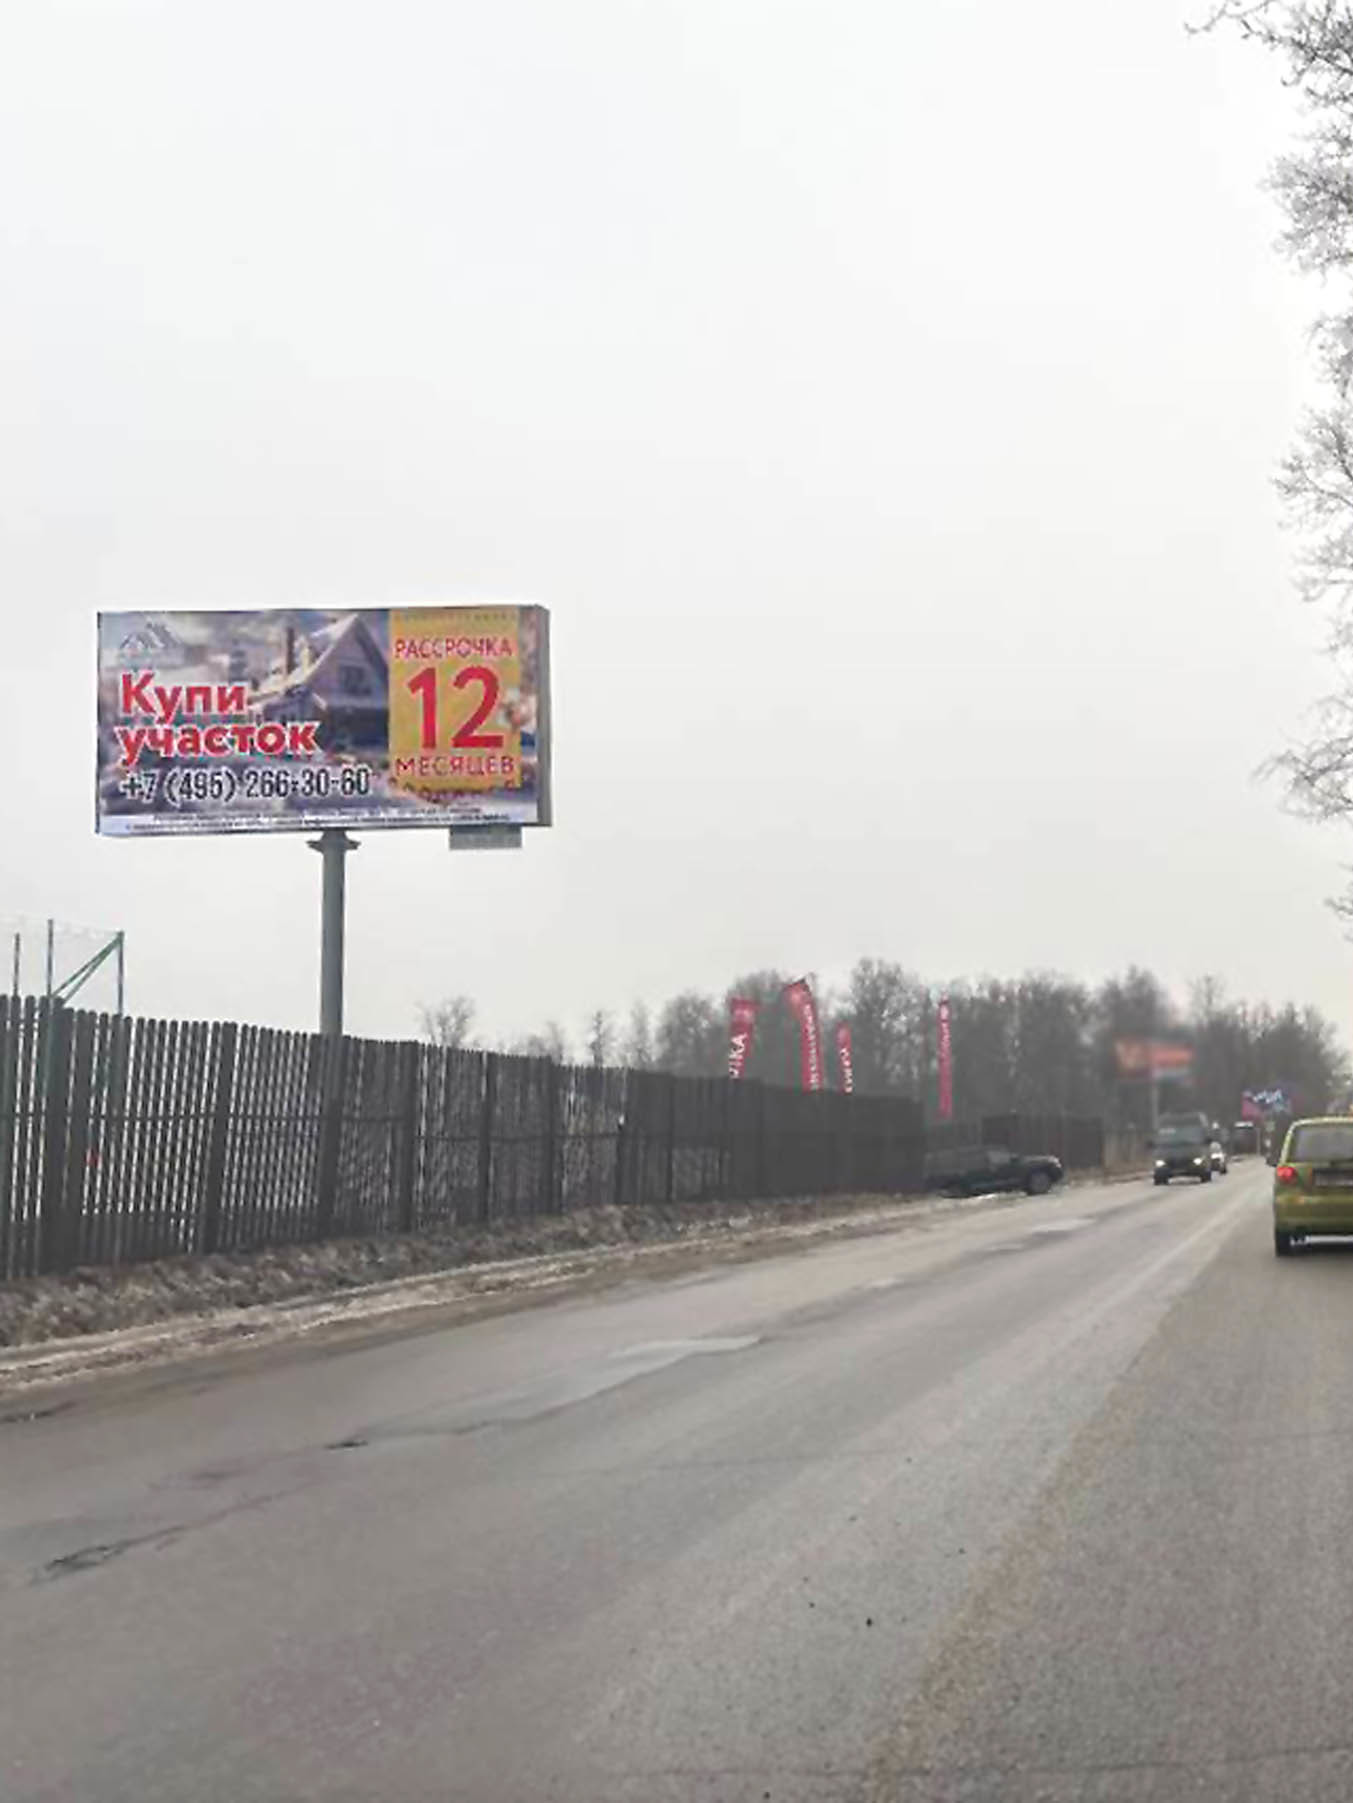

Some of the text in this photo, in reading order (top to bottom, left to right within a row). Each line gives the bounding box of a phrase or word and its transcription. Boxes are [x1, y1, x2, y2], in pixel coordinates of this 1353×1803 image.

[394, 636, 513, 659] РАССРОЧКА
[121, 671, 248, 725] Купи
[408, 665, 504, 749] 12
[115, 722, 321, 767] участок
[121, 769, 158, 802] +7
[166, 768, 237, 804] (495)
[395, 755, 515, 777] МЕСЯЦЕВ
